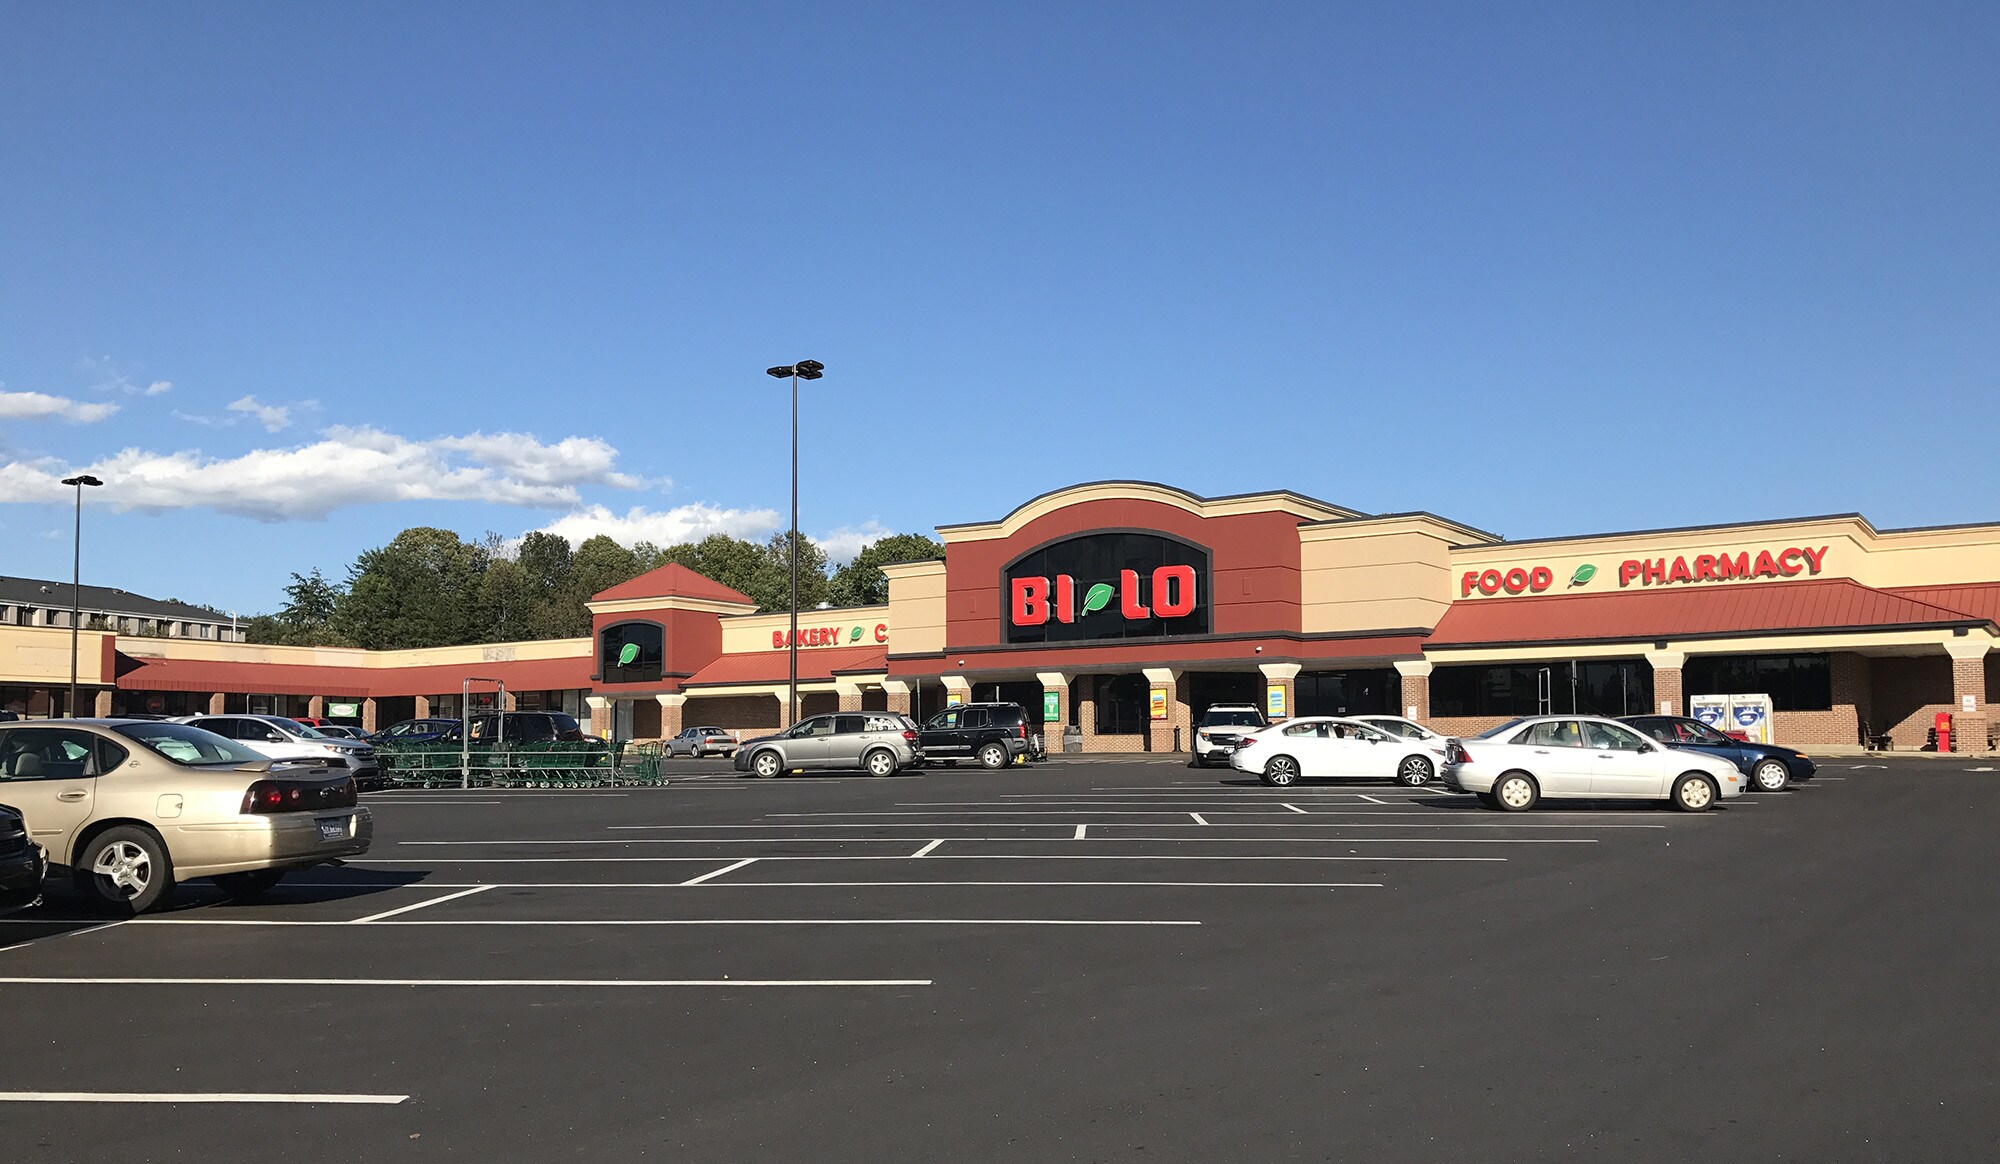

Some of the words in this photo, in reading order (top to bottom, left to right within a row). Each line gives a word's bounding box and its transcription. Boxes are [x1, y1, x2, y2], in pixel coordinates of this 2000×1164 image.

[1462, 566, 1553, 597] FOOD
[1620, 545, 1830, 587] PHARMACY
[772, 626, 842, 648] BAKERY
